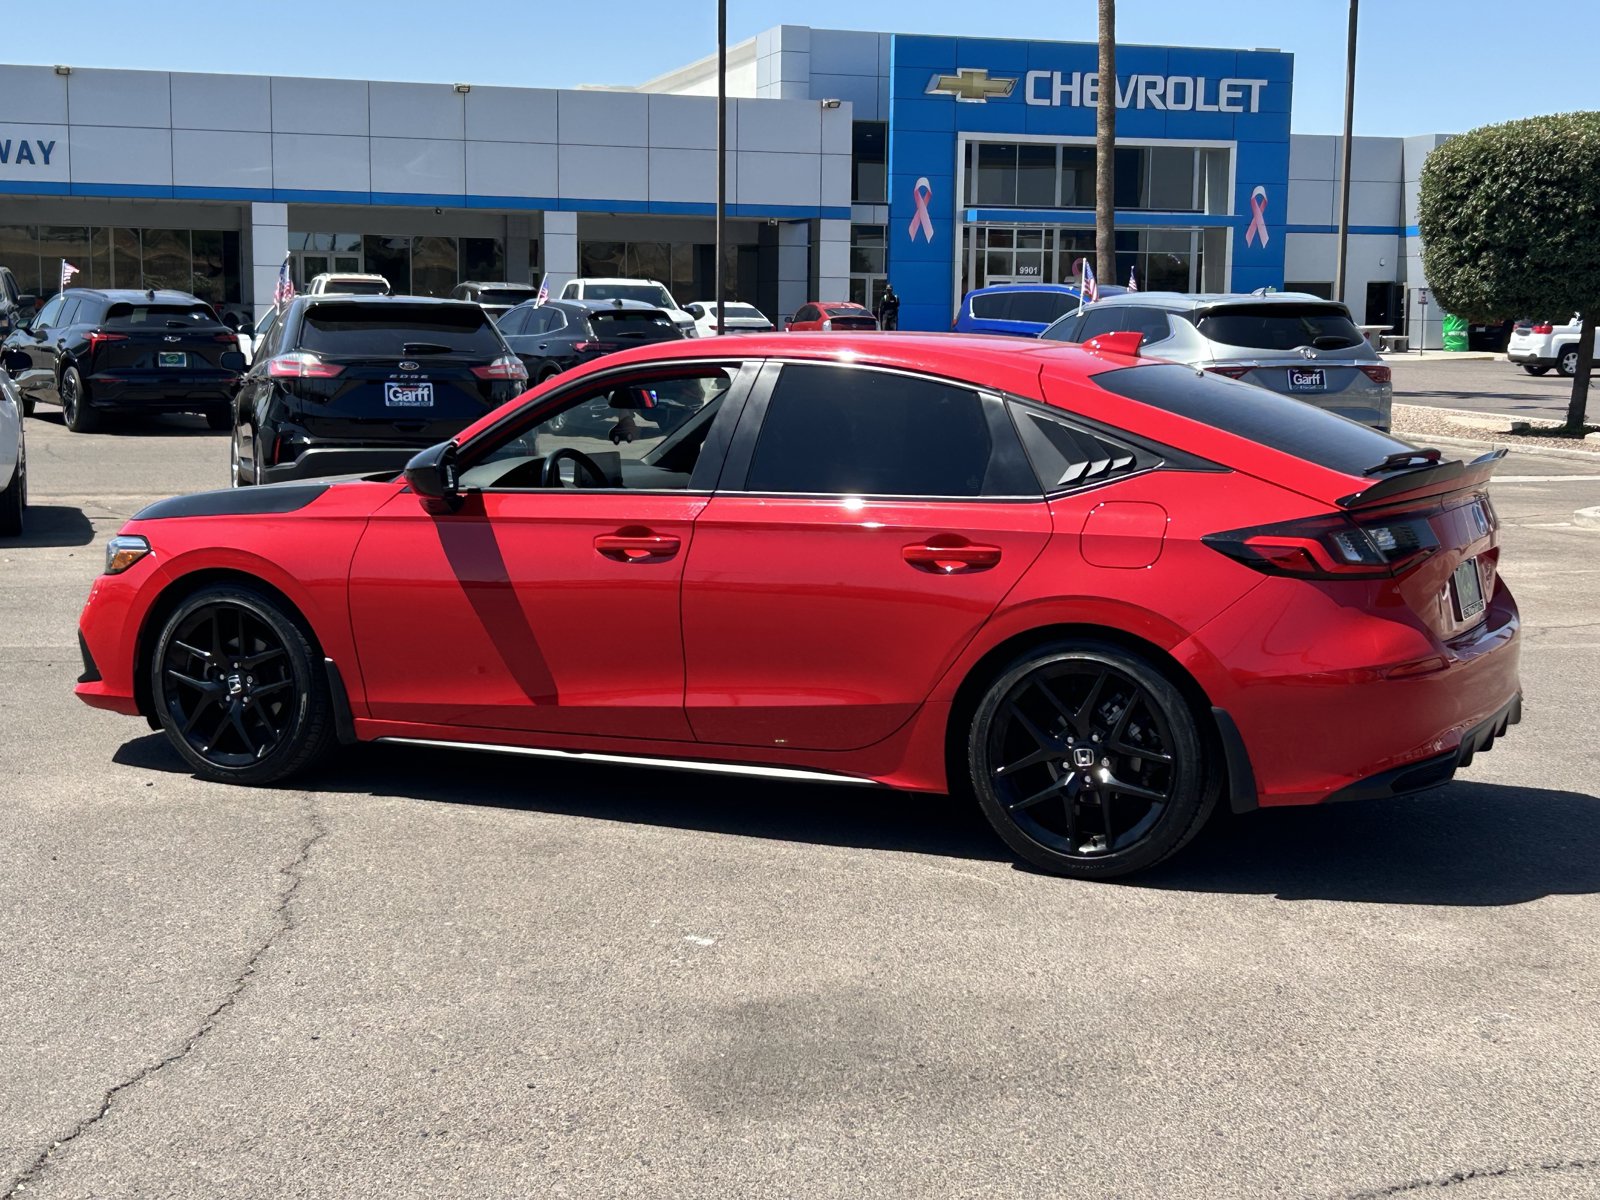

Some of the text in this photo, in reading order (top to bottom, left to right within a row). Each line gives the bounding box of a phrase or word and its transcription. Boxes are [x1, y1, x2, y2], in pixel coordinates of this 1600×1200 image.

[1025, 69, 1268, 113] CHEVROLET
[1019, 266, 1038, 275] 9901
[1293, 373, 1320, 385] Garff
[389, 387, 430, 402] Garff
